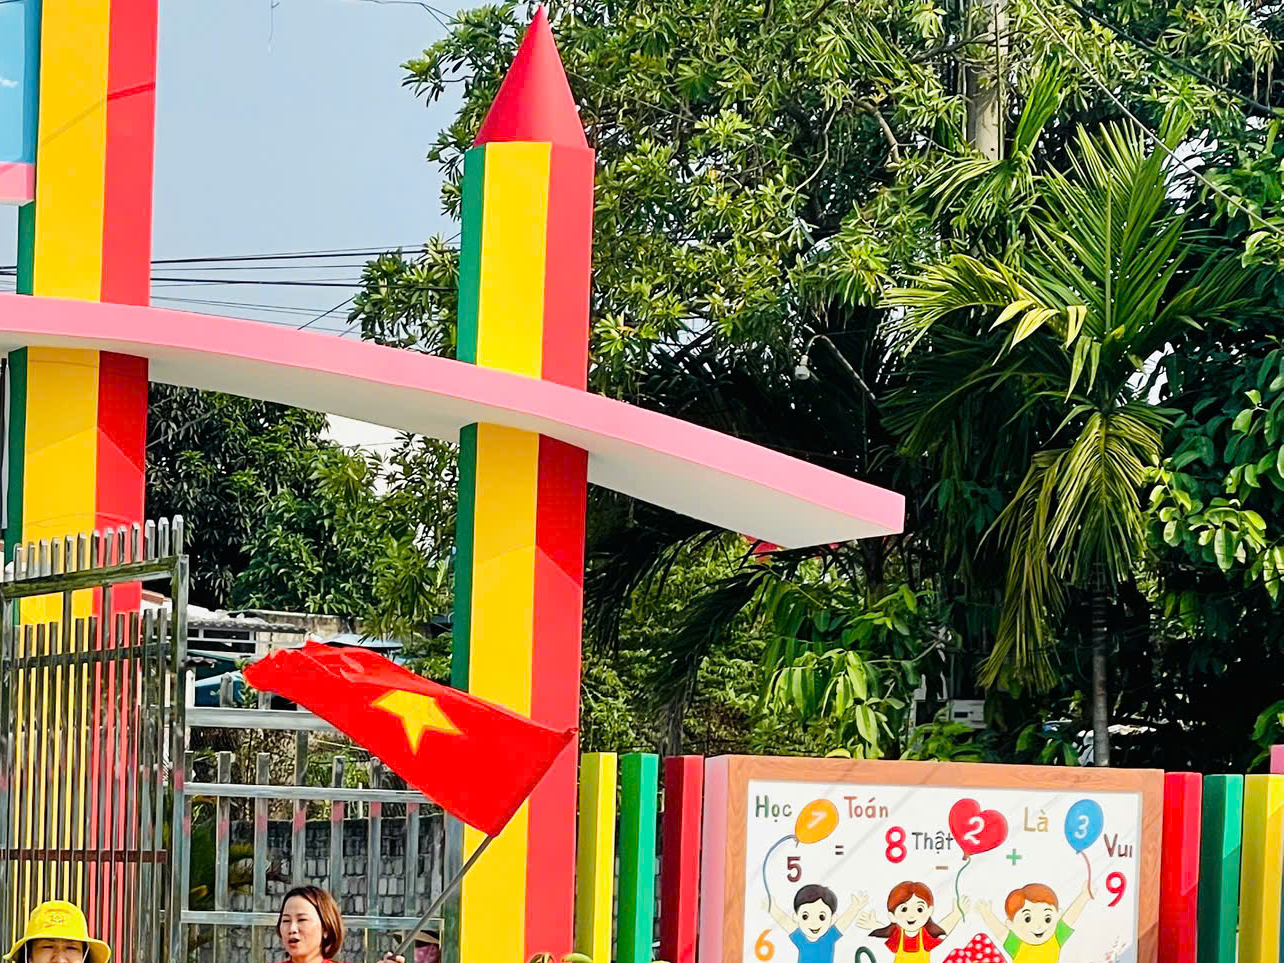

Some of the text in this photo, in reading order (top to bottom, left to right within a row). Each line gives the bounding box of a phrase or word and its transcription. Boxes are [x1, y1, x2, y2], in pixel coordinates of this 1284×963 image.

[755, 795, 1133, 858] Học Toán Thật Là Vui
[963, 815, 985, 845] 2
[1074, 814, 1089, 840] 3
[885, 826, 907, 864] 8
[786, 856, 802, 883] 5
[1105, 871, 1127, 907] 9
[754, 928, 775, 962] 6
